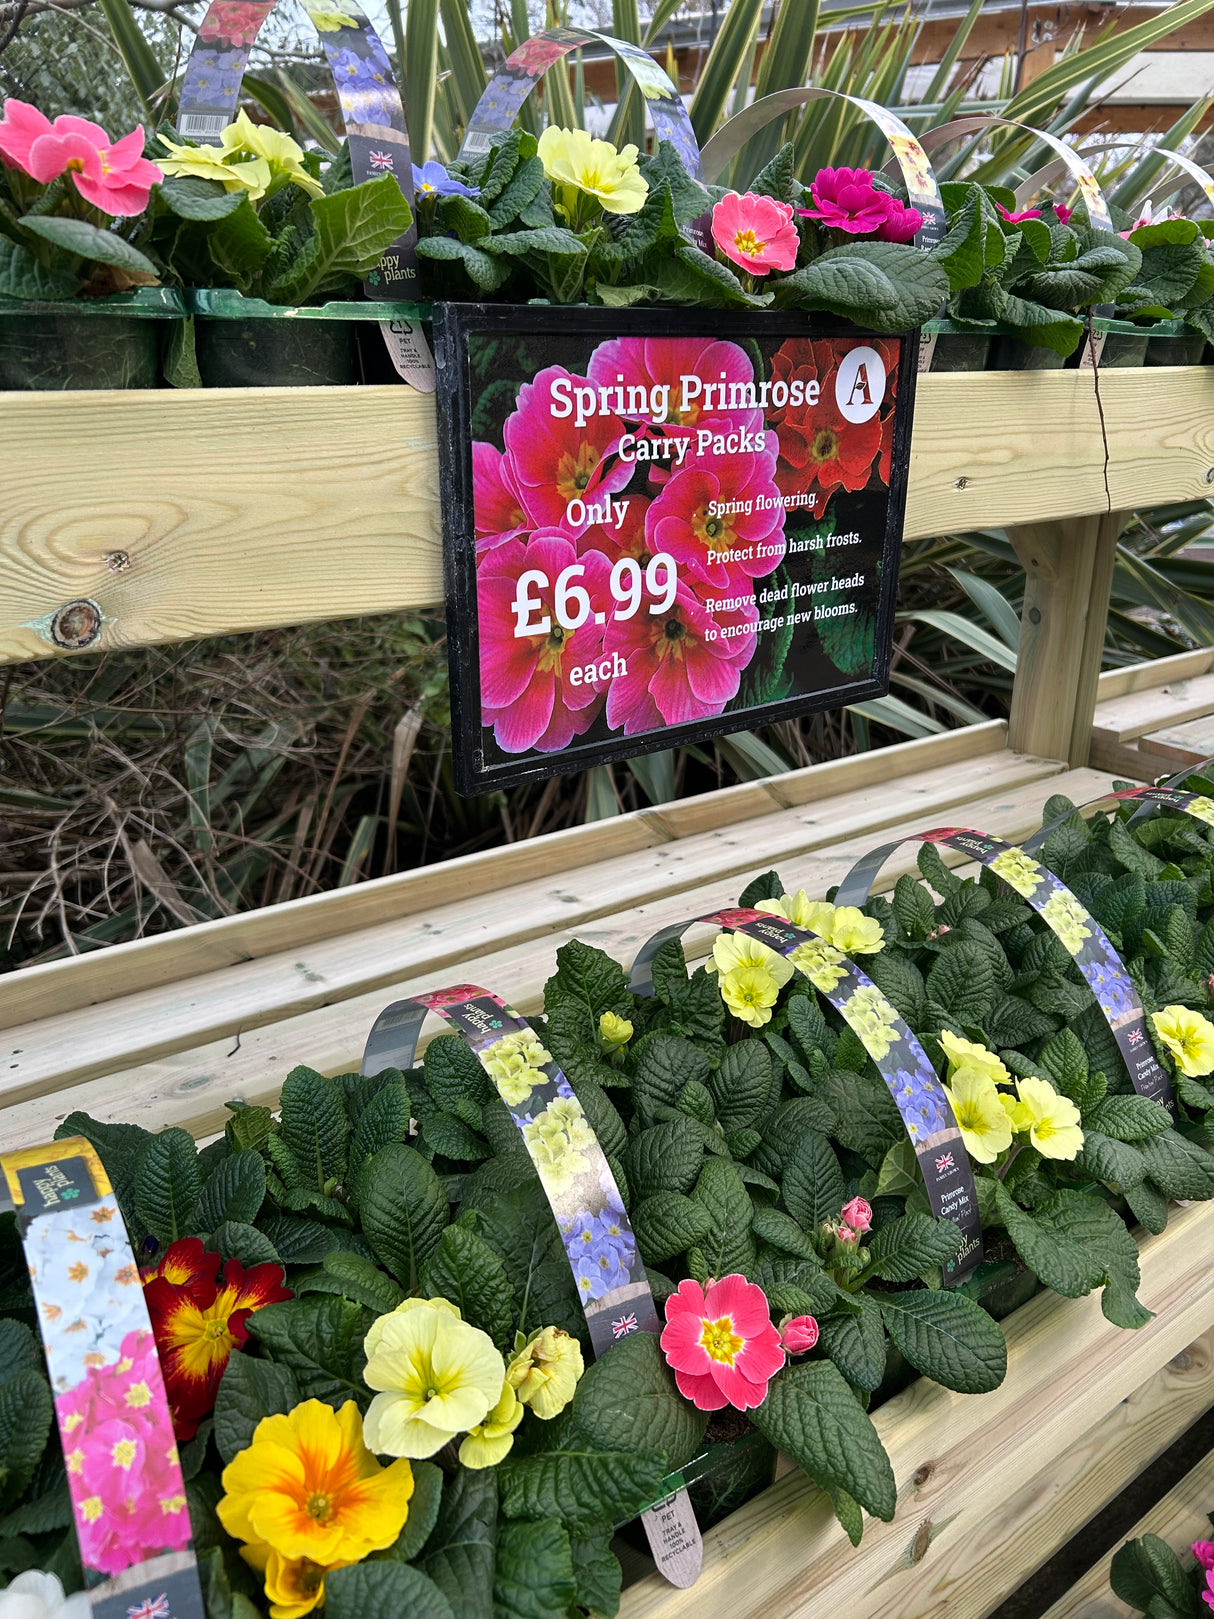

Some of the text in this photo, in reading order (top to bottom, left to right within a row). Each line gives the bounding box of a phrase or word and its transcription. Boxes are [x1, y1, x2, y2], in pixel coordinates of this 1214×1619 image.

[378, 255, 400, 271] ppy
[384, 267, 416, 284] plants
[549, 371, 820, 427] Spring Primrose
[618, 426, 766, 465] Carry Packs
[566, 495, 630, 529] Only
[707, 491, 819, 518] Spring flowering.
[706, 530, 863, 565] Protect from harsh frosts.
[511, 552, 678, 638] £6.99
[705, 572, 865, 613] Remove dead flower heads
[704, 602, 858, 641] to encourage new blooms.
[569, 652, 628, 687] each
[960, 842, 988, 854] happy
[755, 922, 785, 934] plants
[758, 929, 788, 944] happy
[463, 1003, 494, 1020] plants
[462, 1012, 492, 1035] happy
[1138, 1068, 1151, 1081] Candy
[44, 1165, 75, 1188] plants
[33, 1178, 61, 1208] happy
[941, 1186, 965, 1203] Primrose
[940, 1195, 970, 1215] Candy Mix
[956, 1238, 980, 1265] plants
[661, 1510, 675, 1522] PET
[662, 1525, 678, 1536] TRAY
[663, 1528, 686, 1544] HANDLE
[661, 1538, 697, 1562] RECYCLABLE
[669, 1539, 684, 1550] 100%
